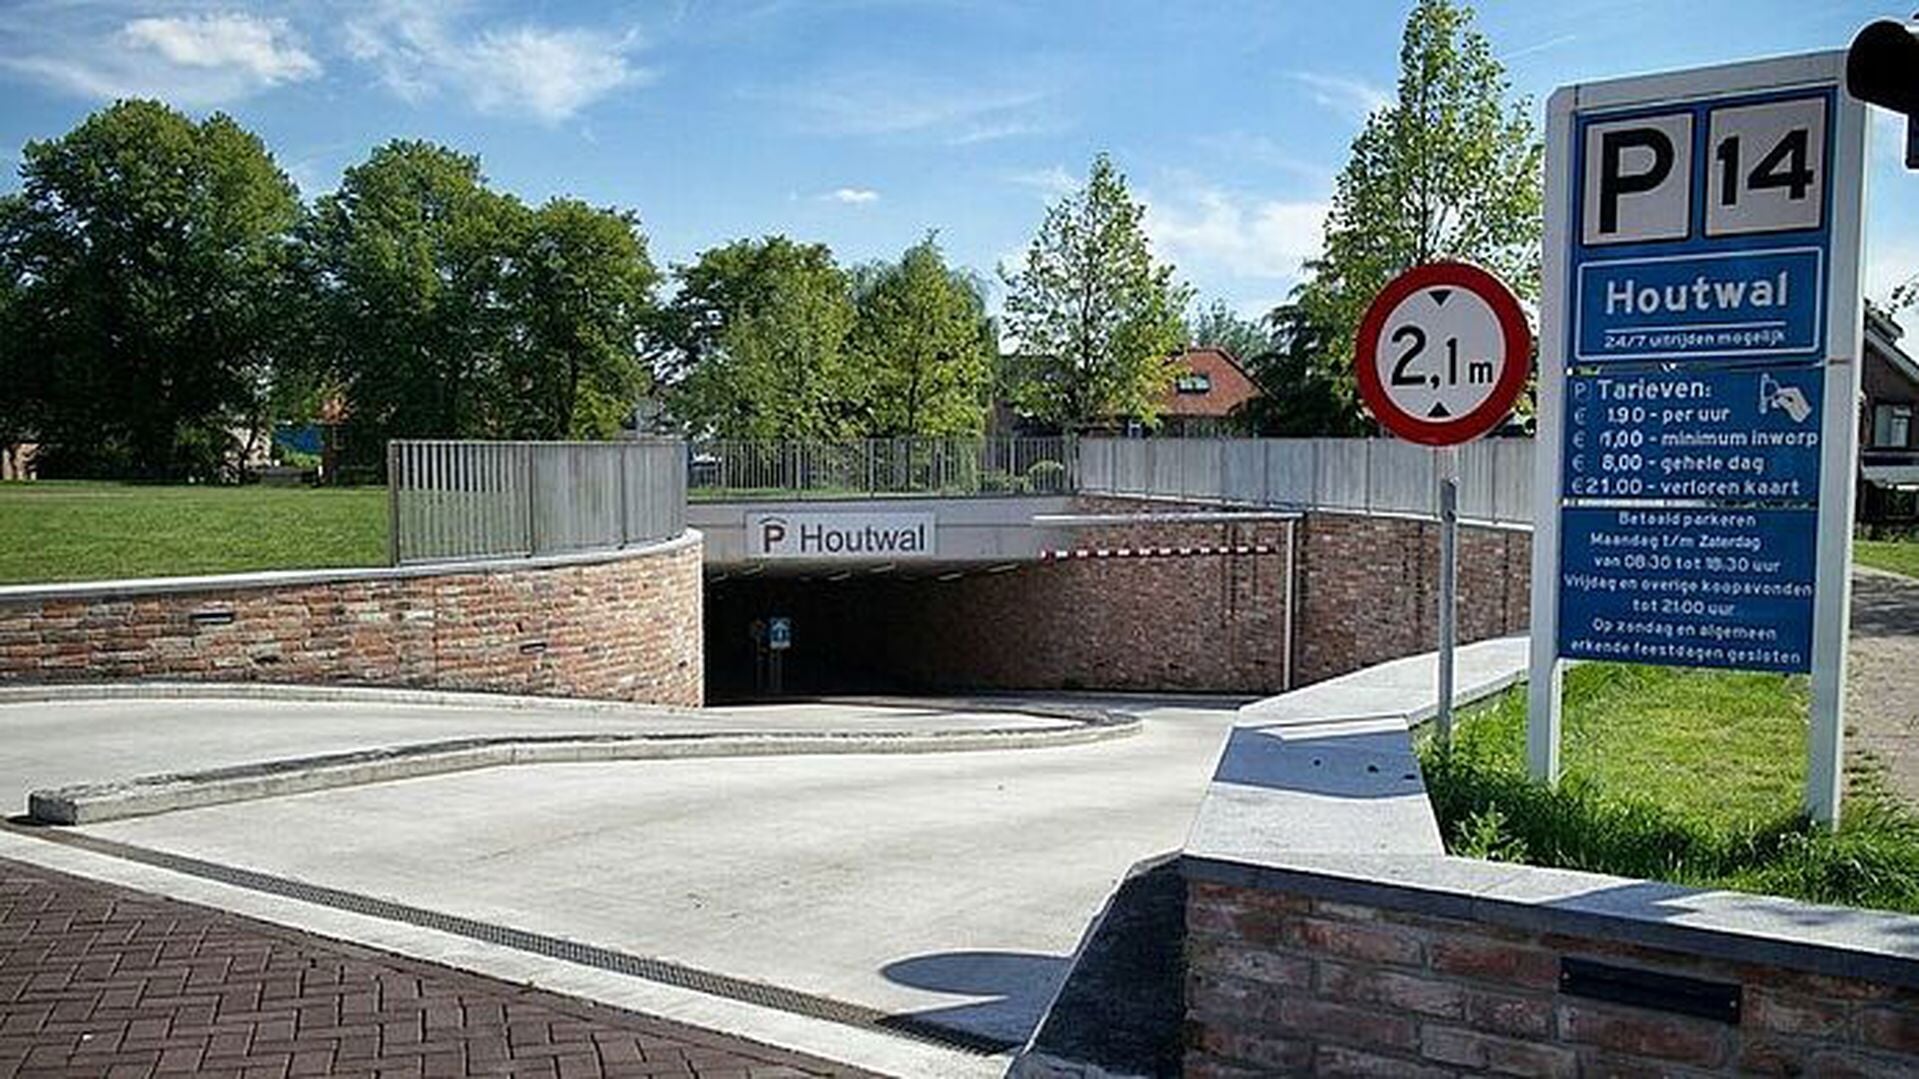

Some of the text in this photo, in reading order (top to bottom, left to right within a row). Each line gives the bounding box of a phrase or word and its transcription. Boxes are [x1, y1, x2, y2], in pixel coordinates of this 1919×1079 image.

[1716, 128, 1814, 206] 14
[1598, 128, 1675, 234] P
[1605, 270, 1788, 315] Houtwal
[1604, 334, 1646, 349] 24/7
[1597, 378, 1711, 400] Tarieven:
[1662, 408, 1694, 425] per
[1699, 407, 1731, 421] uur
[1660, 430, 1748, 446] minimum
[1751, 429, 1819, 447] inworp
[1660, 453, 1723, 475] gehele
[1727, 455, 1765, 475] dag
[1660, 477, 1740, 496] verloren
[1743, 477, 1801, 496] kaart
[764, 524, 925, 553] P Houtwal
[1590, 532, 1660, 551] Maandag
[1594, 556, 1621, 568] van
[1676, 556, 1701, 570] tot
[1752, 560, 1782, 573] uur
[1563, 573, 1617, 593] Vrijdag
[1619, 578, 1639, 590] en
[1632, 598, 1658, 613] tot
[1707, 602, 1737, 616] uur
[1592, 617, 1614, 635] Op
[1616, 619, 1674, 637] zondag
[1676, 624, 1696, 636] en
